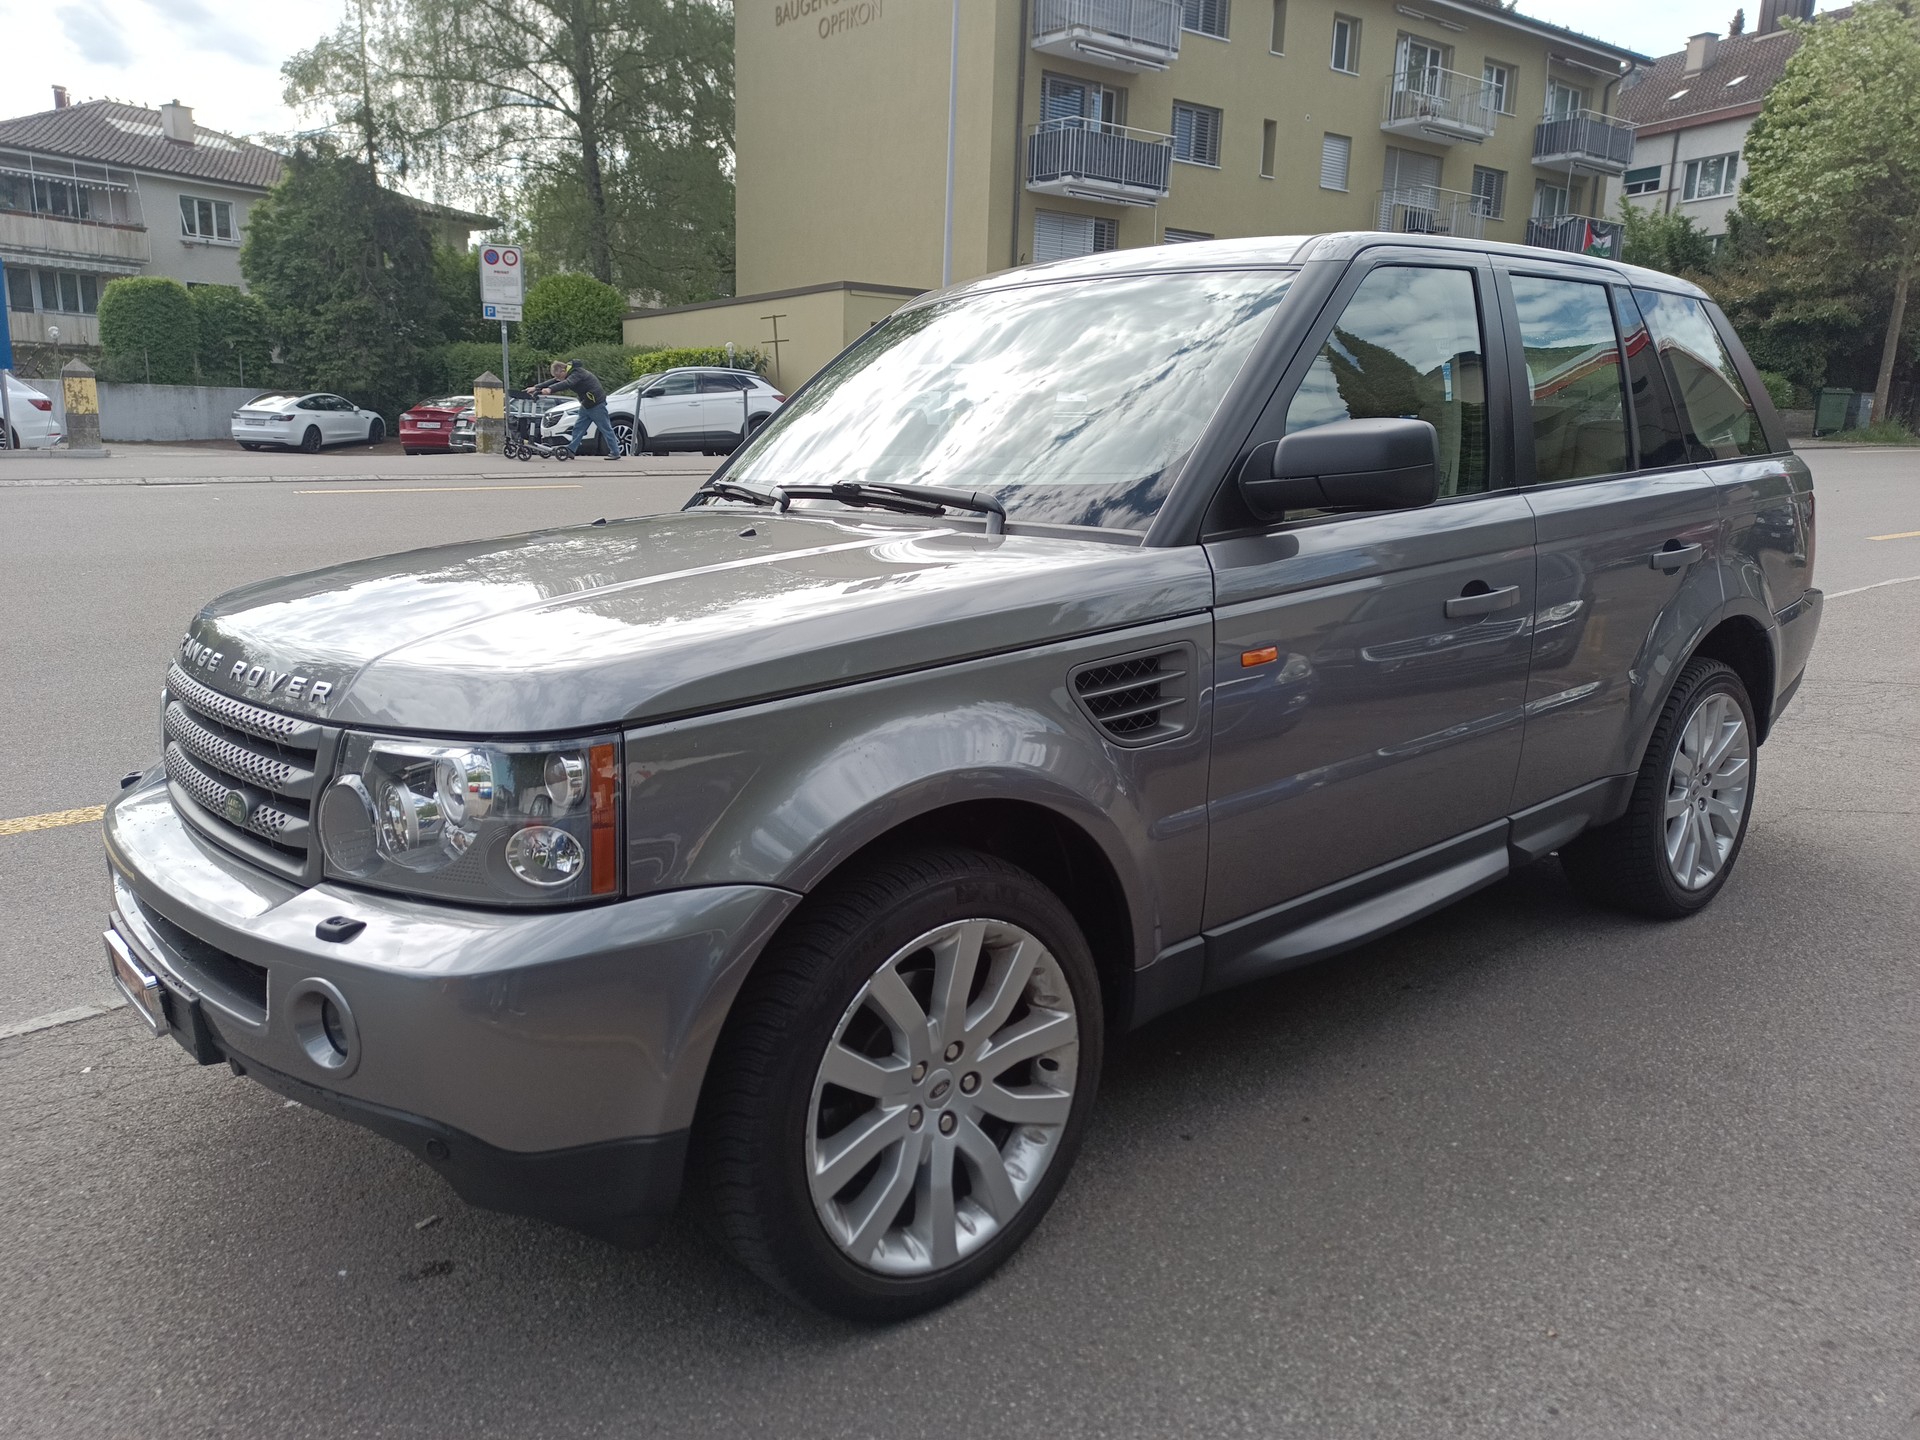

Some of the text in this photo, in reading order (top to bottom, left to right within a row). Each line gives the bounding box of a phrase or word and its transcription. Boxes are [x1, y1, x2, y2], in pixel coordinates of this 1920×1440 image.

[818, 0, 882, 39] OPFIKON
[179, 632, 333, 704] RANGE ROVER
